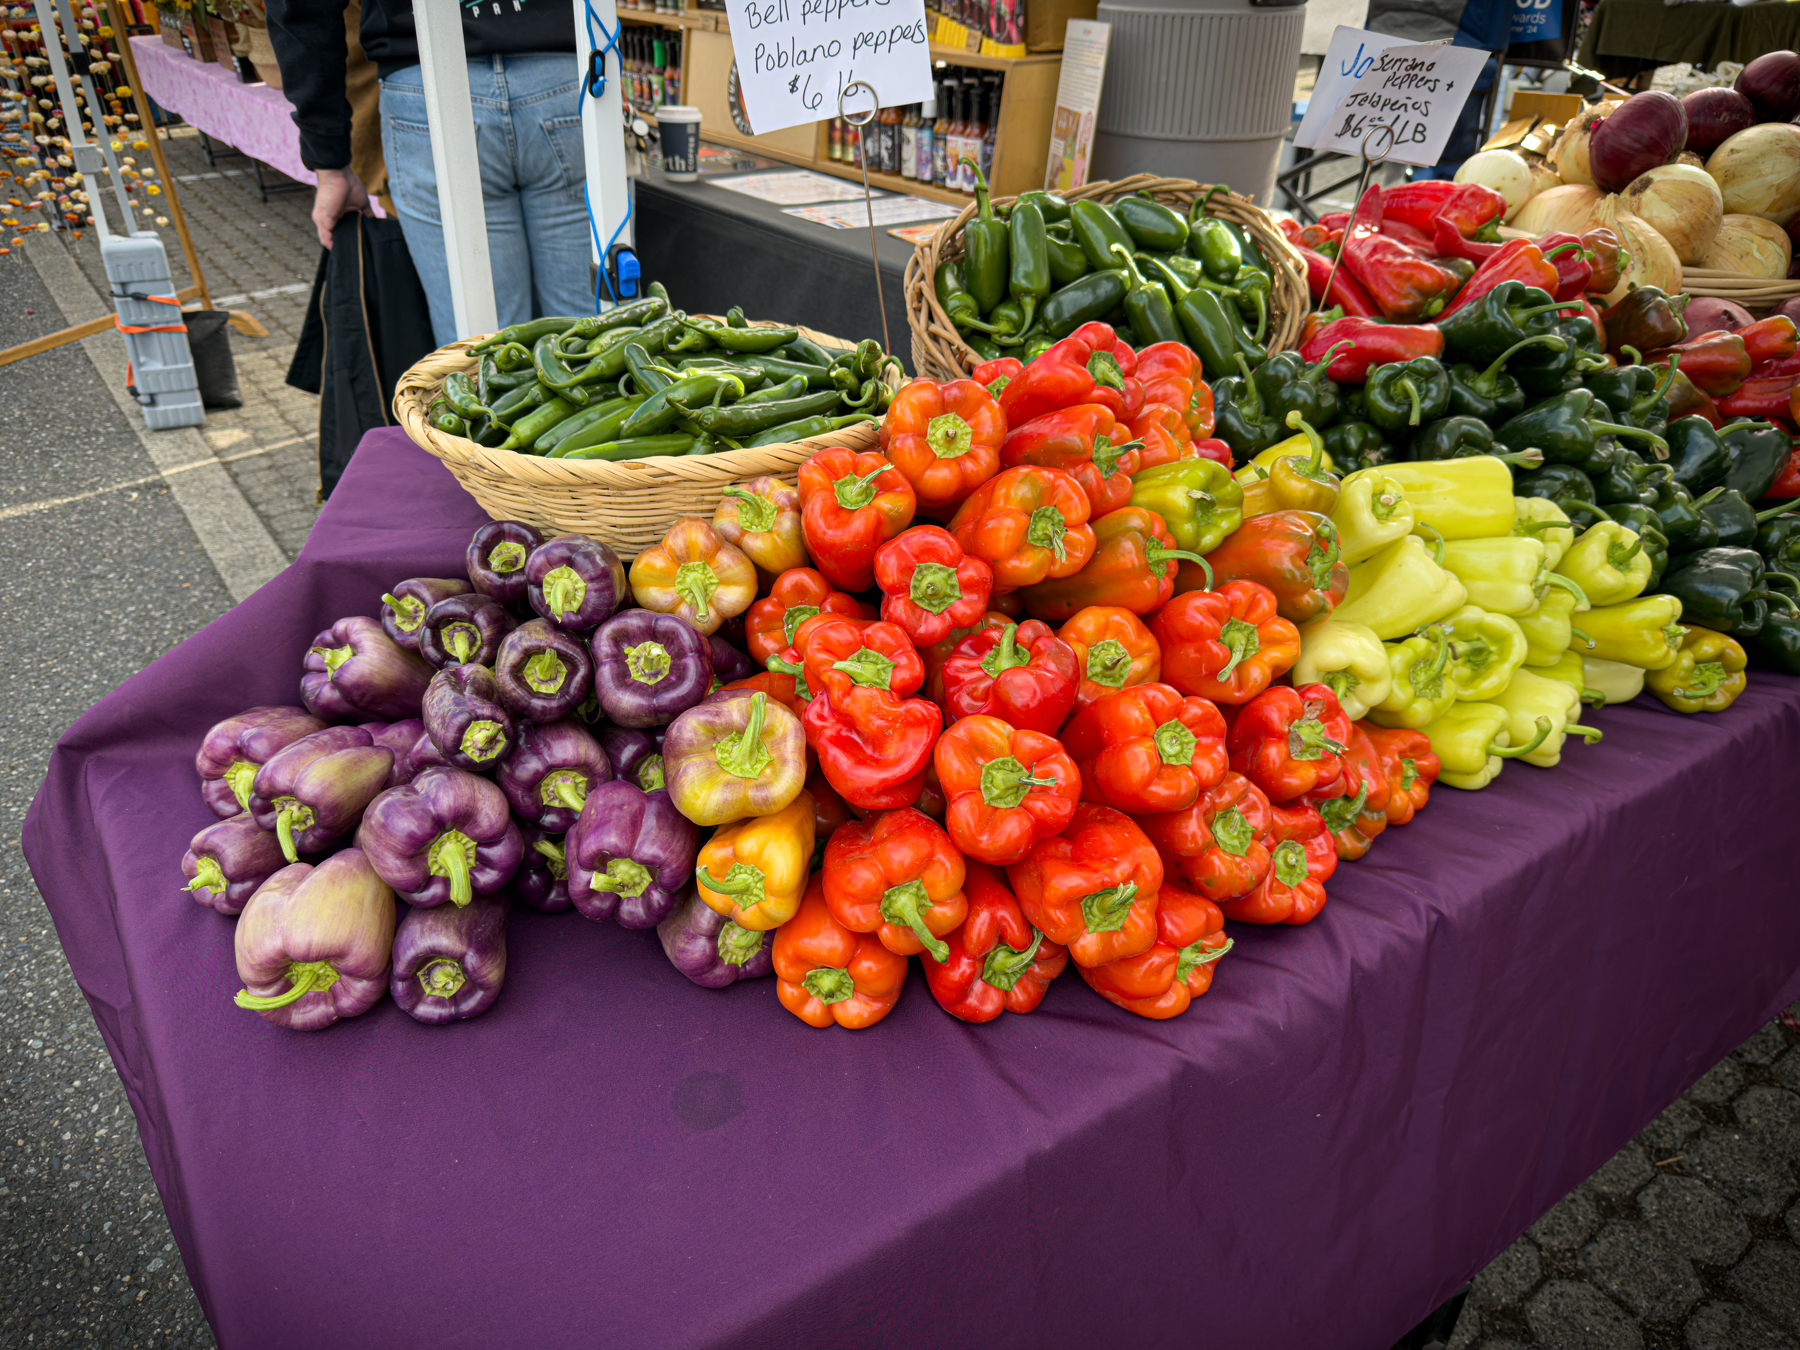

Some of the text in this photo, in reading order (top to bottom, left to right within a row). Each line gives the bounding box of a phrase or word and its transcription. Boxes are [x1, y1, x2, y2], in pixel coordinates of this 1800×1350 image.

[744, 0, 790, 30] Bell
[800, 0, 891, 26] pepp
[754, 36, 842, 74] Poblano
[852, 18, 926, 60] peppers
[1371, 53, 1437, 72] Serrano
[788, 73, 823, 110] $6
